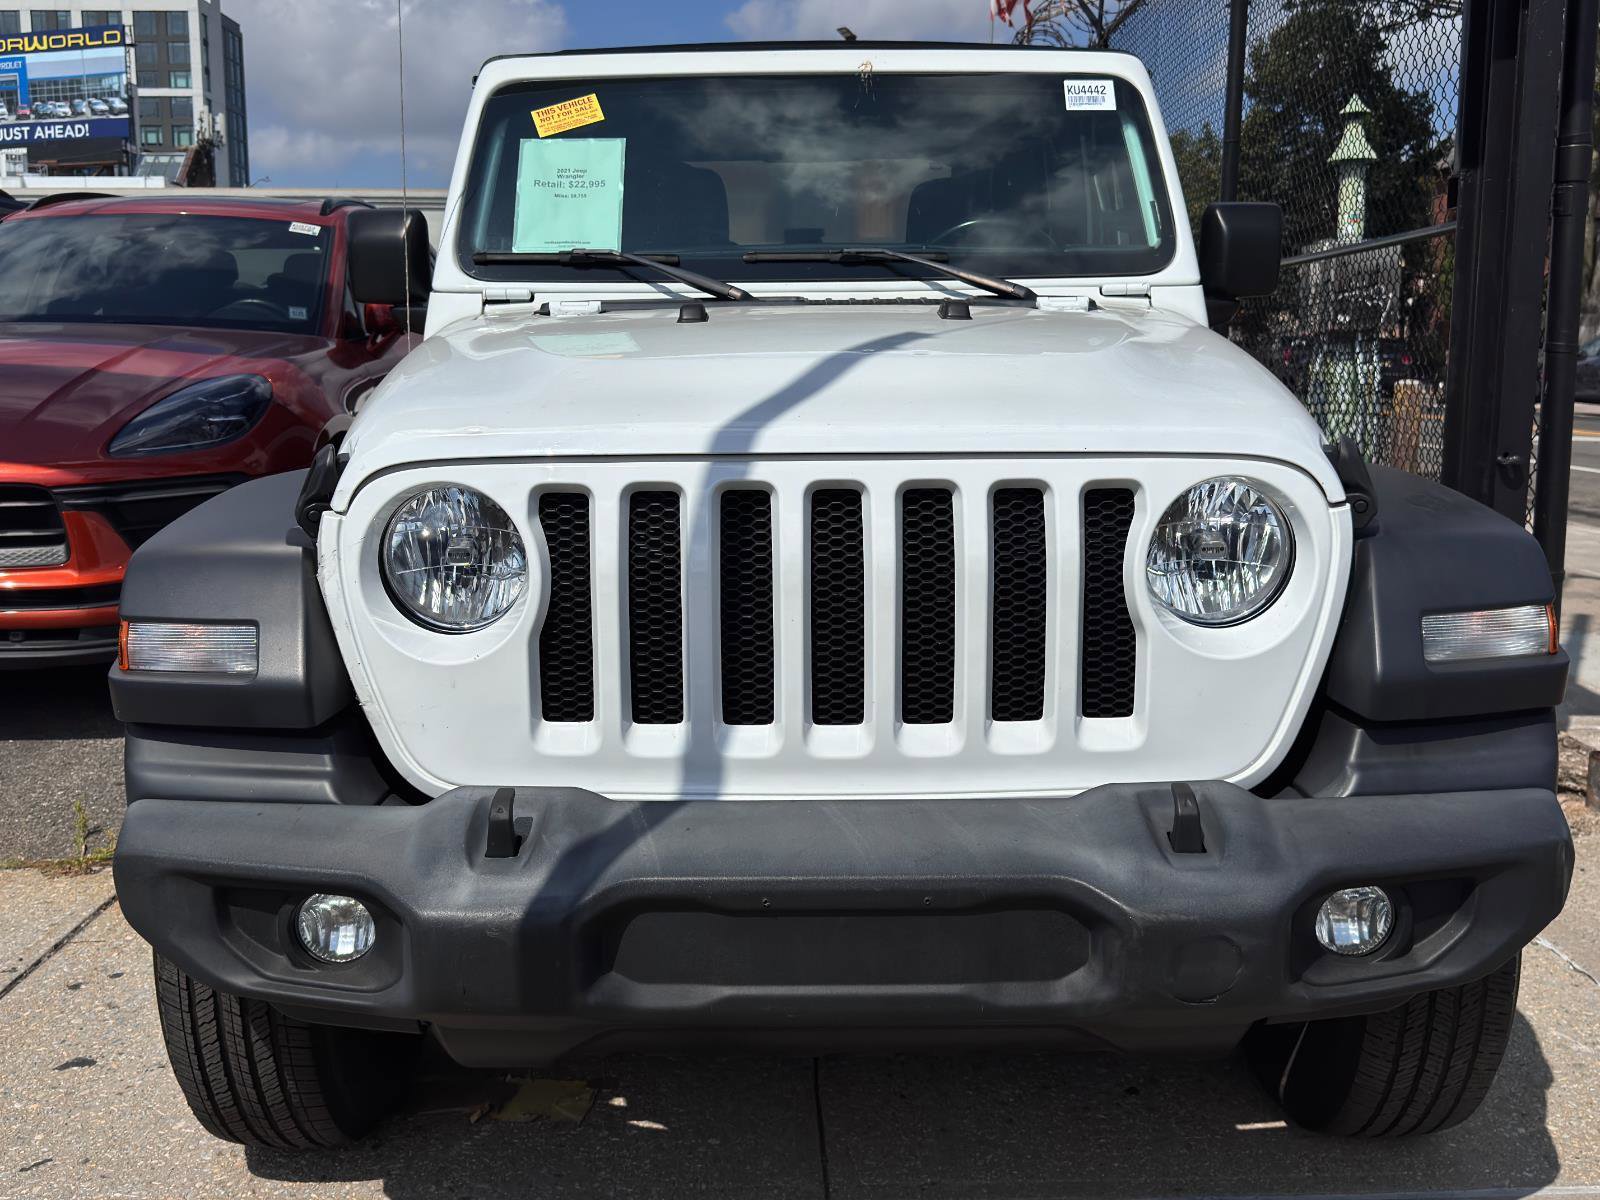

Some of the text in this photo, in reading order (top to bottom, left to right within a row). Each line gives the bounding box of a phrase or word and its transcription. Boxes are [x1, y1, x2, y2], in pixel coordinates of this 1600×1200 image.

[1066, 85, 1107, 95] KU4442
[535, 107, 556, 118] THIS
[556, 96, 594, 111] VEHICLE
[539, 114, 555, 124] NOT
[556, 110, 573, 119] FOR
[574, 104, 594, 114] SALE
[34, 123, 90, 139] AHEAD!
[533, 179, 606, 189] Retail: $22,995
